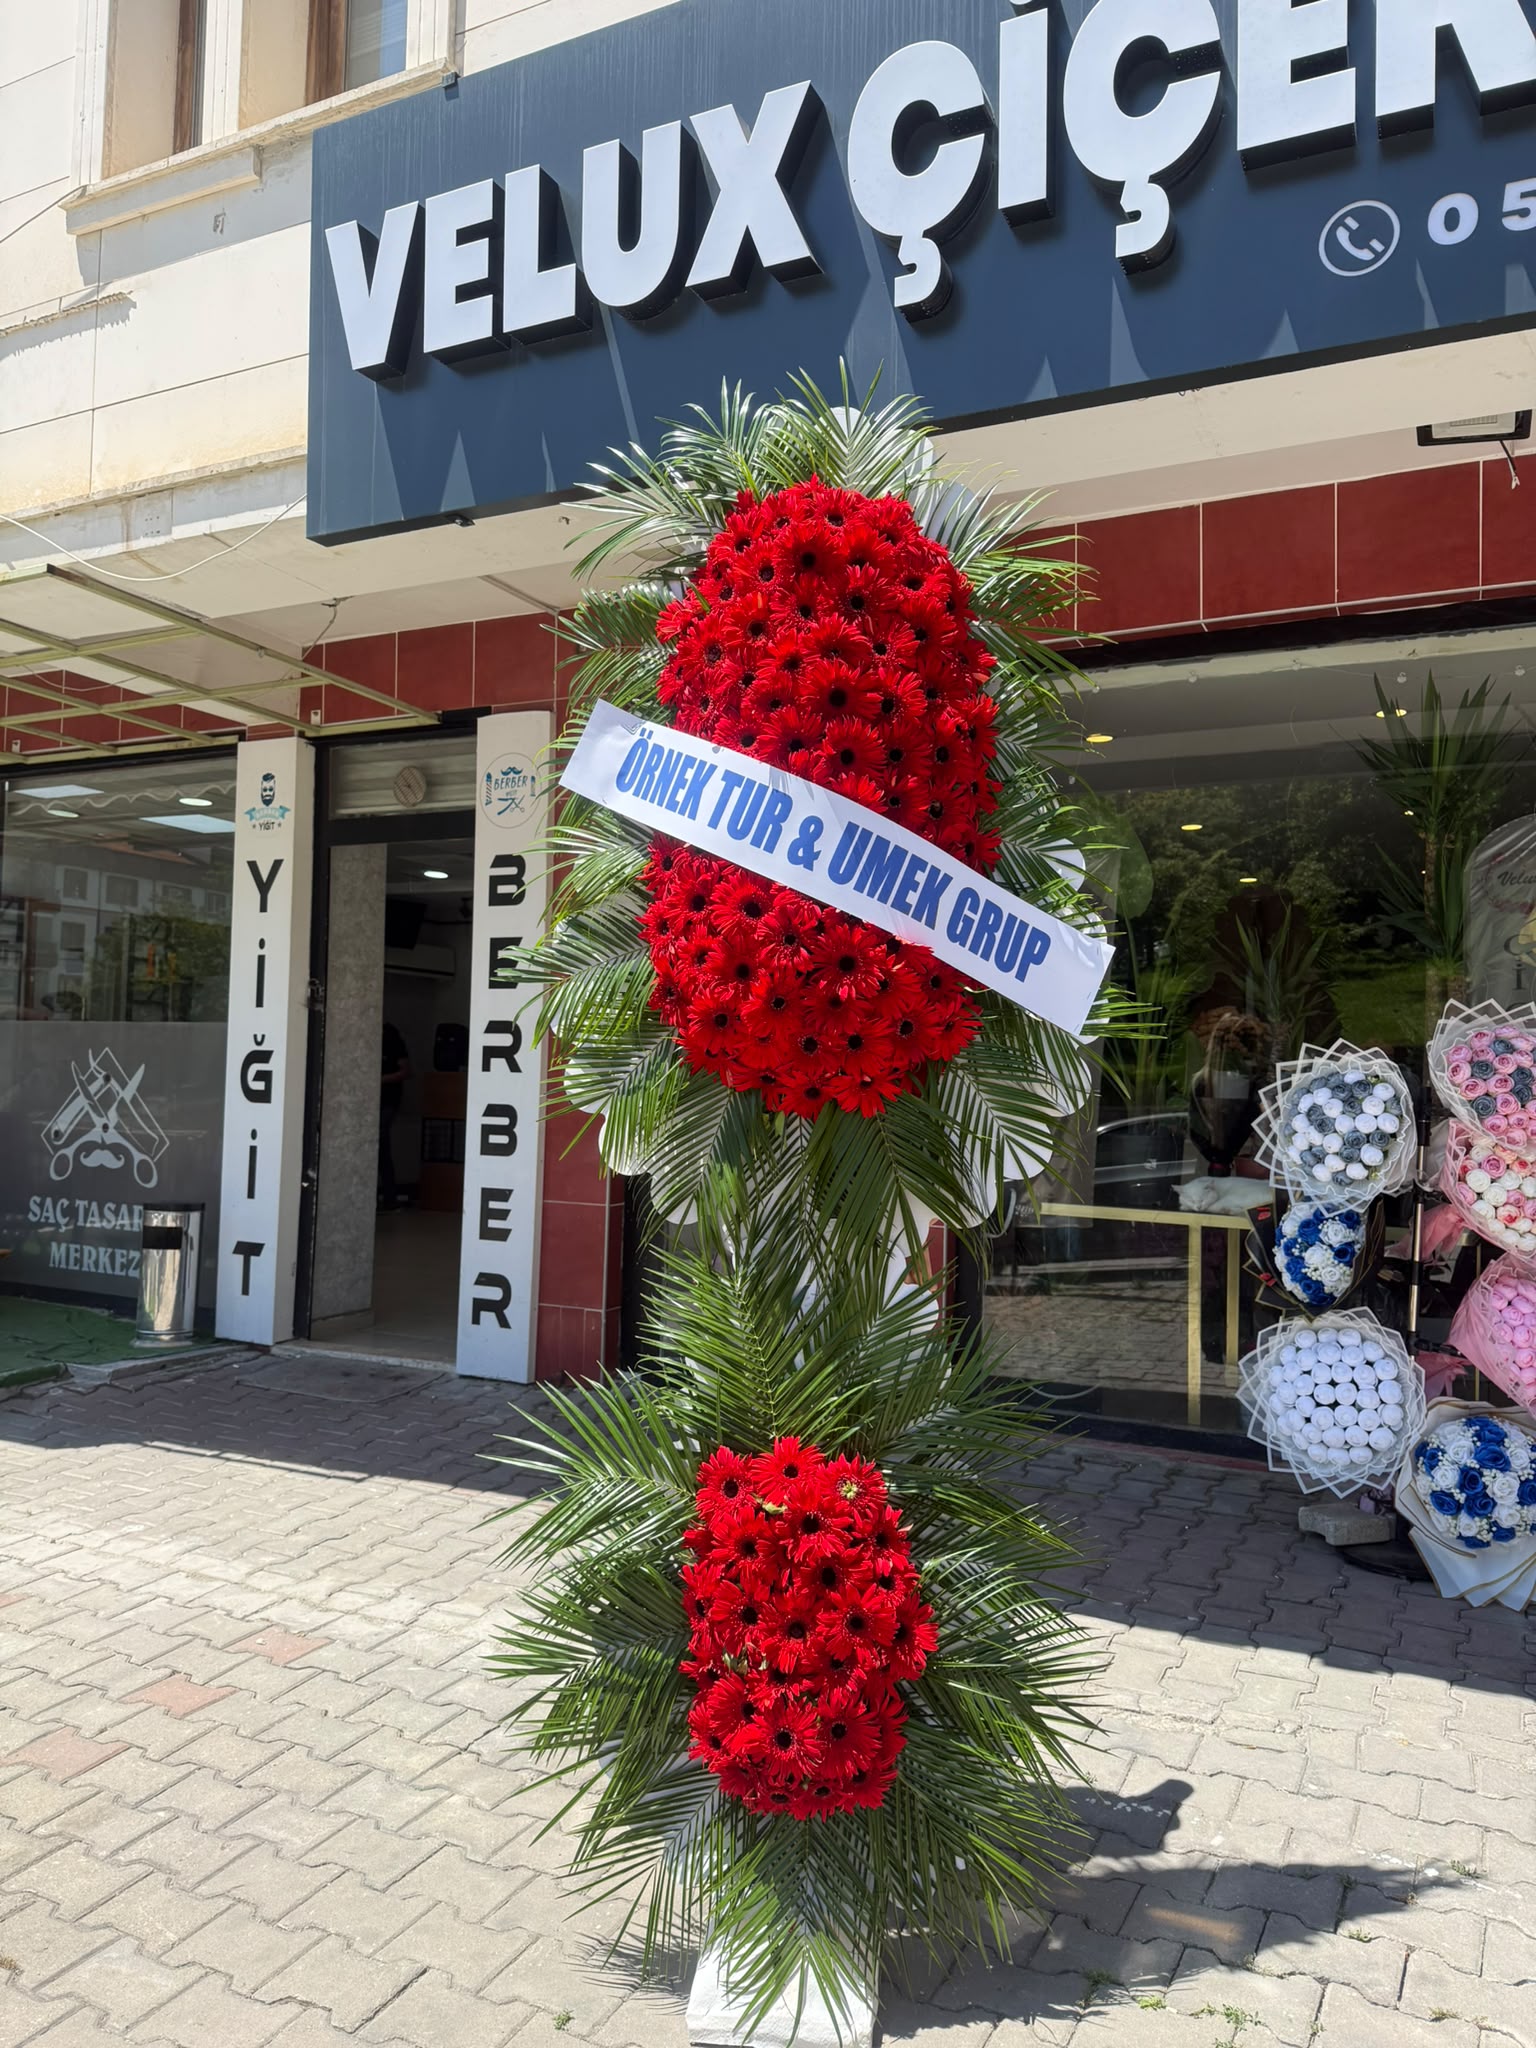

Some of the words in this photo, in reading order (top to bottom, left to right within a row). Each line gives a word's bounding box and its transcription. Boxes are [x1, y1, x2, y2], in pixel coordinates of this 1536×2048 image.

[324, 79, 813, 372] VELUX
[615, 723, 718, 822] ÖRNEK
[706, 769, 794, 854] TUR
[787, 814, 825, 872] &
[827, 821, 954, 931] UMEK
[946, 886, 1052, 983] GRUP
[27, 1195, 70, 1233] SAÇ
[470, 853, 527, 1330] BERBER
